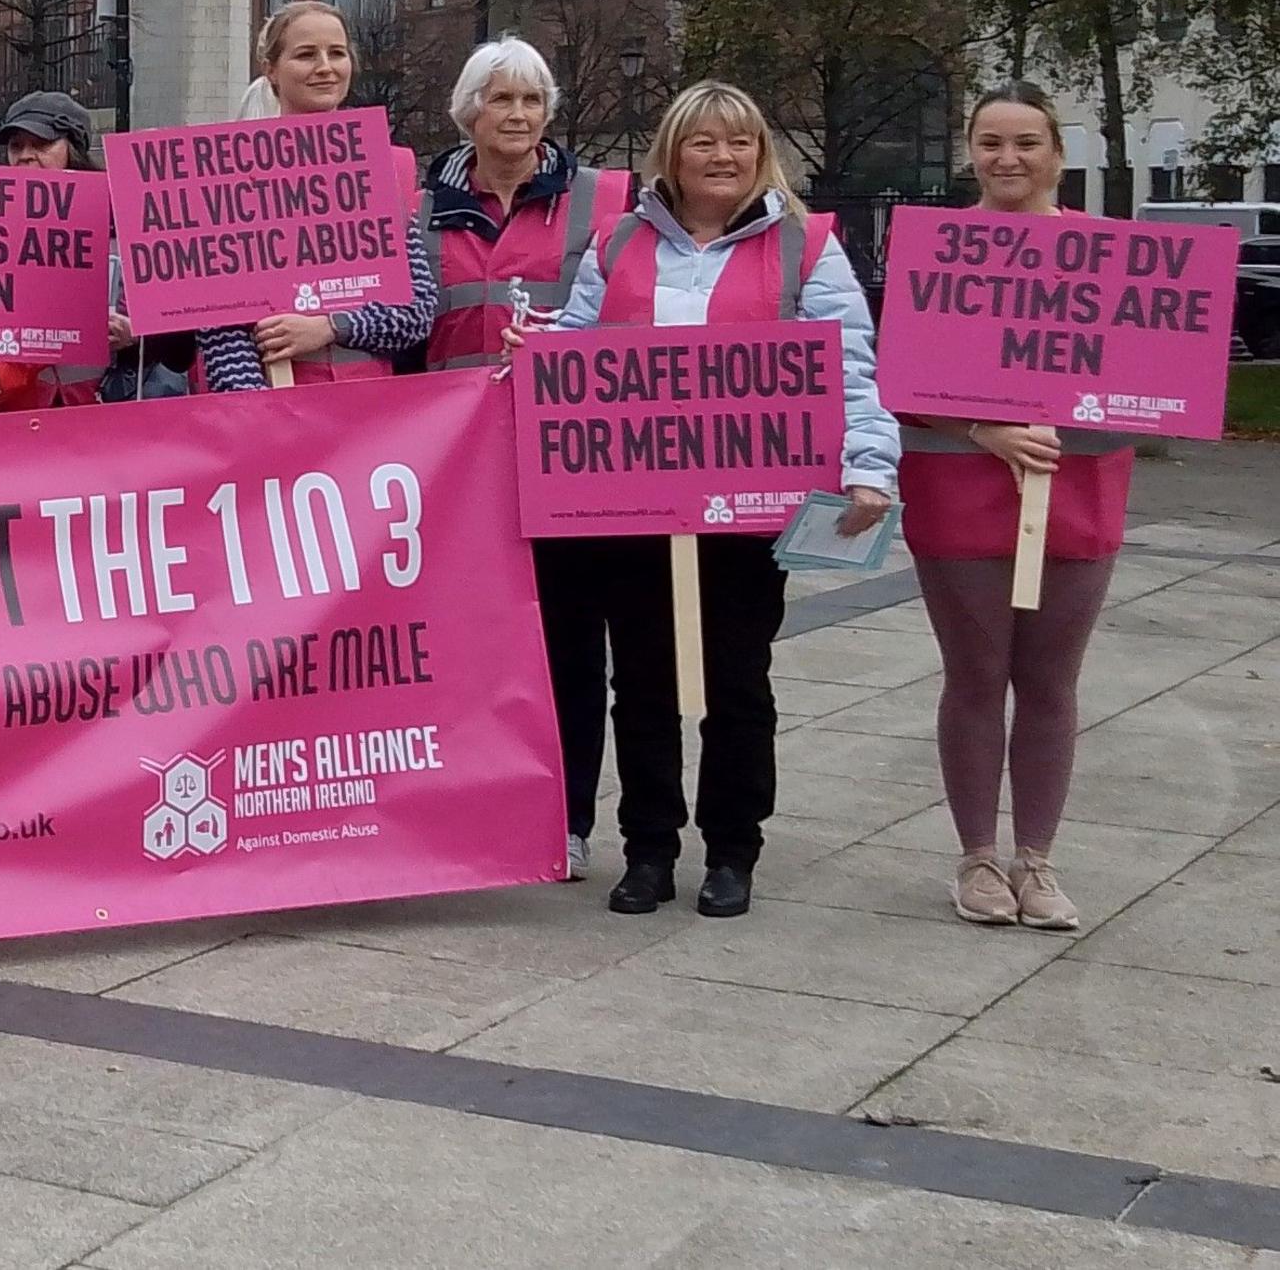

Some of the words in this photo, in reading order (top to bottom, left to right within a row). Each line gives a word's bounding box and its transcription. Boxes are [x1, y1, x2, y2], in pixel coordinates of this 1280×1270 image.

[131, 138, 189, 183] WE
[192, 121, 367, 177] RECOGNISE
[26, 179, 76, 221] DV
[142, 188, 200, 233] ALL
[201, 175, 330, 226] VICTIMS
[335, 170, 372, 213] OF
[18, 227, 94, 269] ARE
[130, 228, 288, 284] DOMESTIC
[296, 217, 397, 268] ABUSE
[935, 222, 1042, 270] 35%
[1055, 230, 1116, 274] OF
[1126, 233, 1194, 280] DV
[908, 270, 1101, 325] VICTIMS
[1111, 286, 1213, 333] ARE
[532, 349, 586, 405] NO
[594, 346, 691, 402] SAFE
[698, 340, 827, 399] HOUSE
[1000, 327, 1104, 377] MEN
[539, 417, 615, 475] FOR
[621, 414, 706, 472] MEN
[713, 413, 753, 469] IN
[761, 411, 826, 469] N.I.
[40, 487, 196, 623] THE
[206, 482, 253, 605] 1
[264, 471, 361, 599] IN
[369, 462, 423, 589] 3
[3, 656, 120, 728] ABUSE
[131, 644, 238, 715] WHO
[247, 634, 319, 702] ARE
[329, 622, 434, 692] MALE
[234, 739, 308, 790] MEN'S
[234, 785, 311, 819] NORTHERN
[315, 779, 377, 809] IRELAND
[236, 834, 281, 852] Against
[283, 826, 339, 846] Domestic
[341, 823, 380, 838] Abuse
